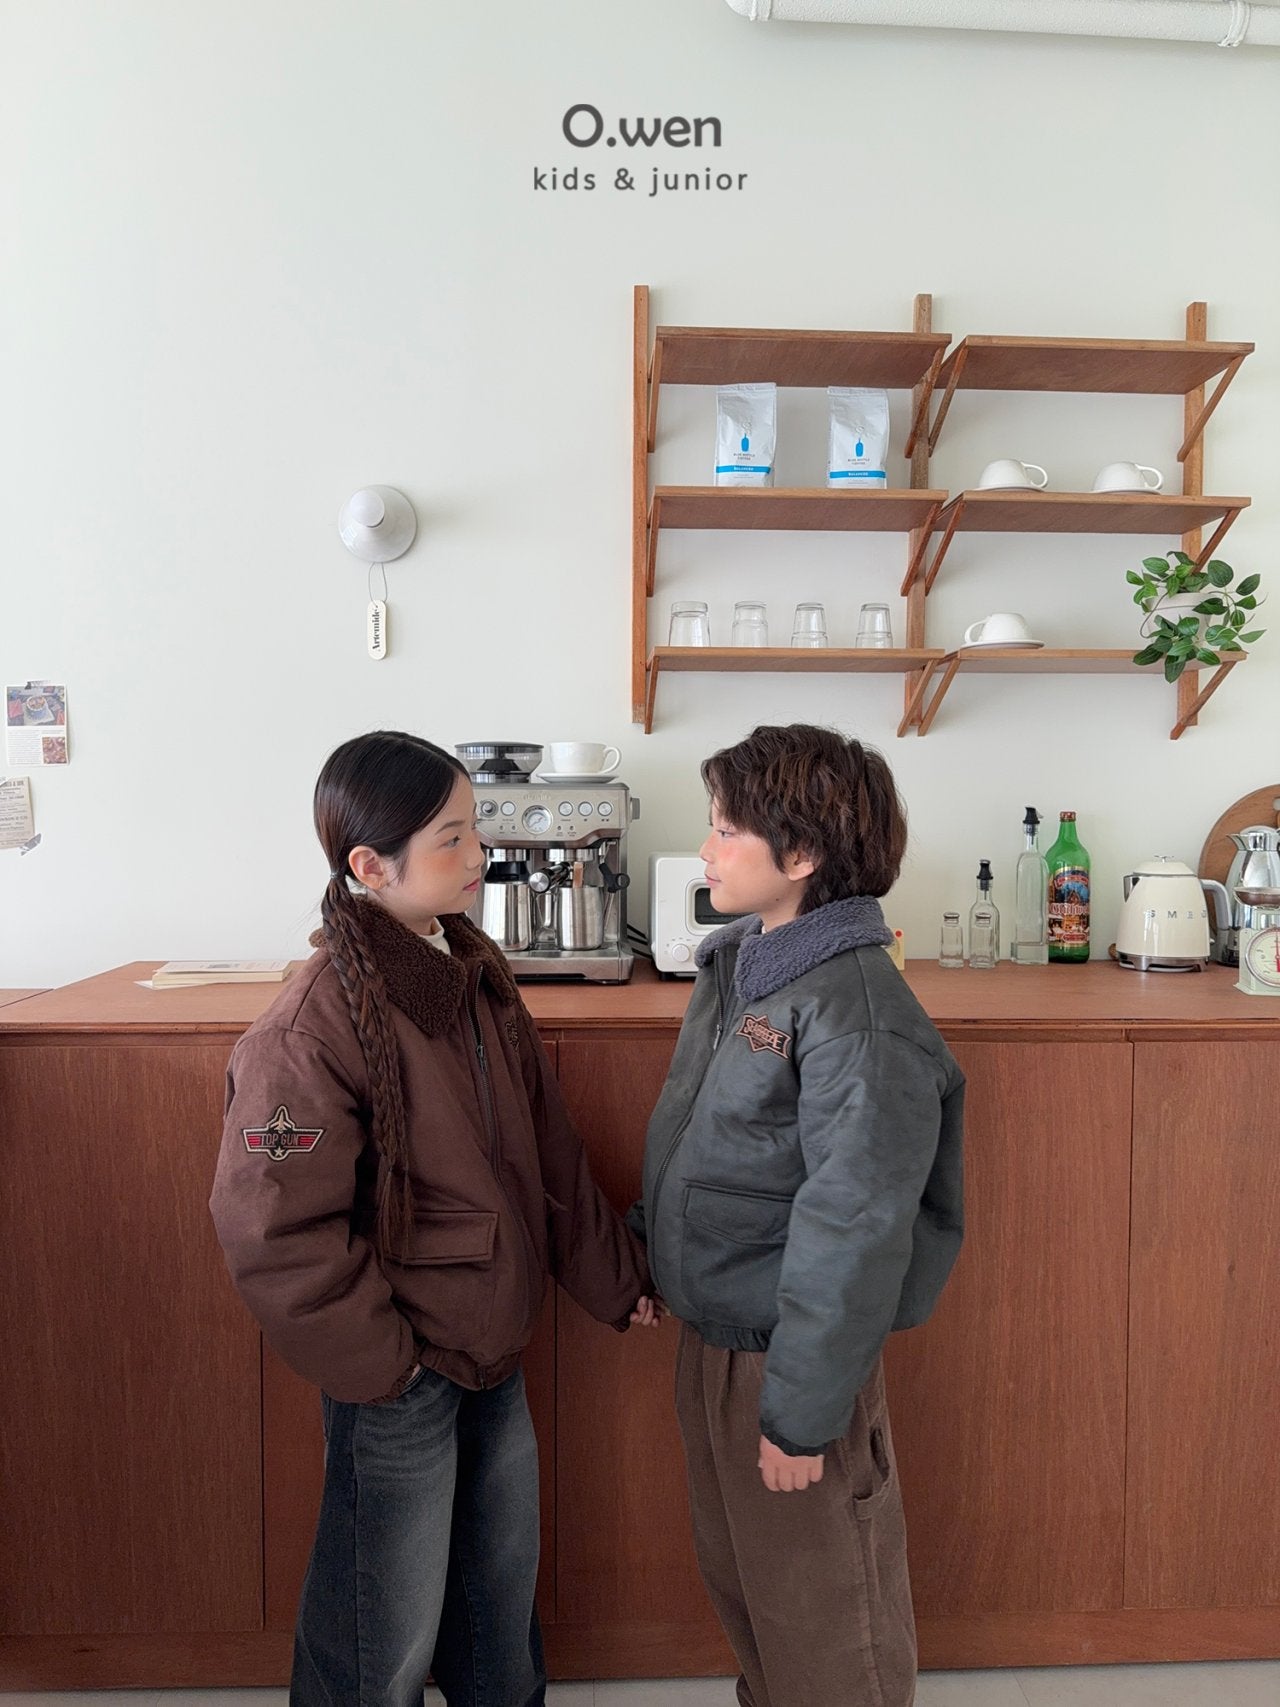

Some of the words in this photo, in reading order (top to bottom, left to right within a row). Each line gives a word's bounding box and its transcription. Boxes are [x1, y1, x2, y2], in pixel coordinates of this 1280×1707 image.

[372, 608, 380, 650] Artemide
[261, 1133, 279, 1147] TOP
[281, 1133, 300, 1147] GUN
